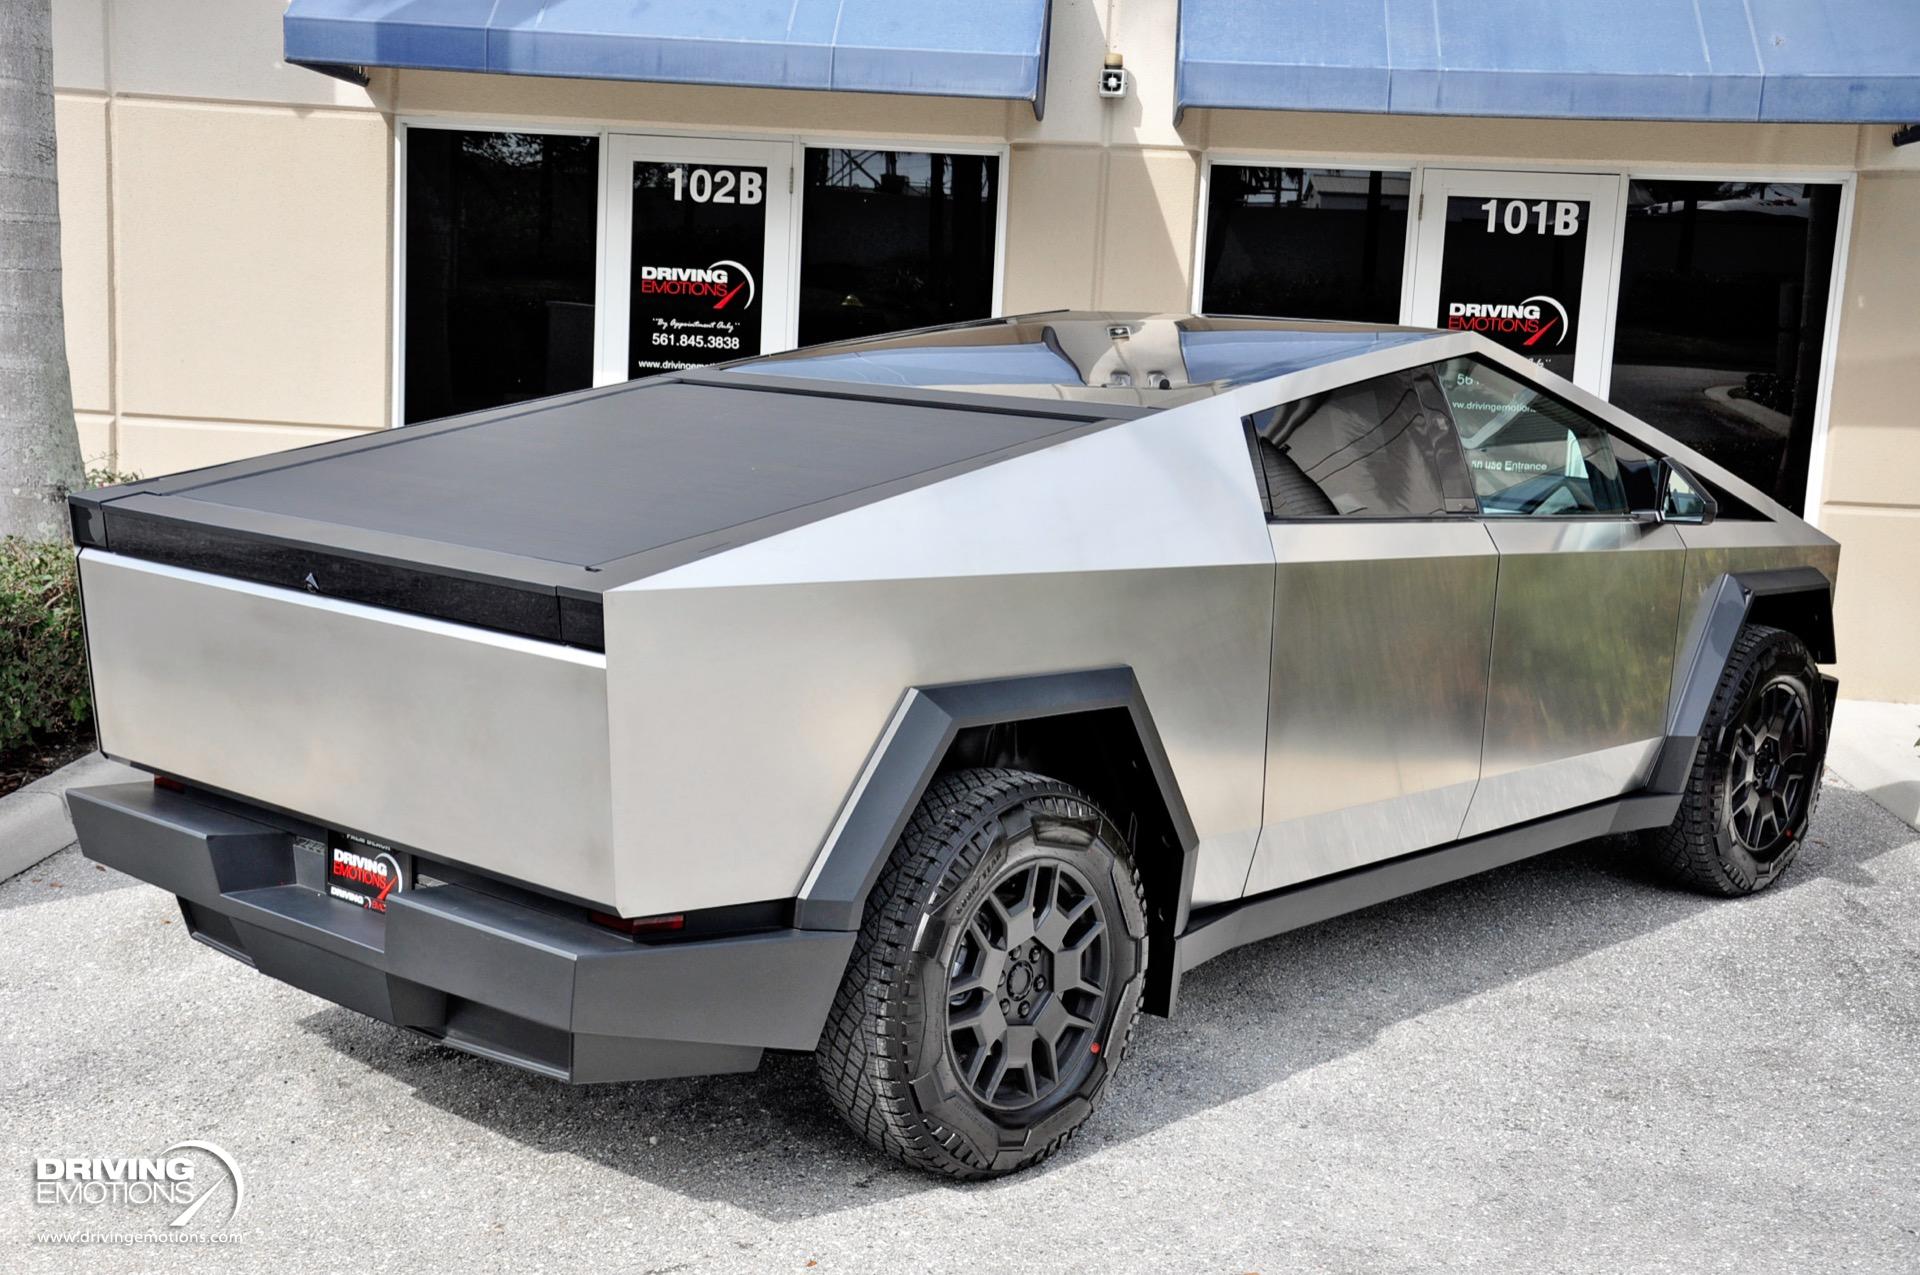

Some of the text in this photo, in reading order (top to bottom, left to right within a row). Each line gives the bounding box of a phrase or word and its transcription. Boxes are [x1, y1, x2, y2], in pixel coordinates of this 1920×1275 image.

[667, 167, 763, 205] 102B
[1481, 199, 1580, 236] 101B
[641, 266, 728, 284] DRIVING
[641, 280, 728, 297] EMOTIONS
[1449, 302, 1541, 320] DRIVING
[669, 318, 716, 329] Appointment
[1448, 316, 1540, 333] EMOTIONS
[651, 332, 740, 350] 561.845.3838
[1504, 460, 1548, 472] Entrance
[333, 848, 388, 877] DRIVING
[333, 860, 388, 889] EMOTIONS
